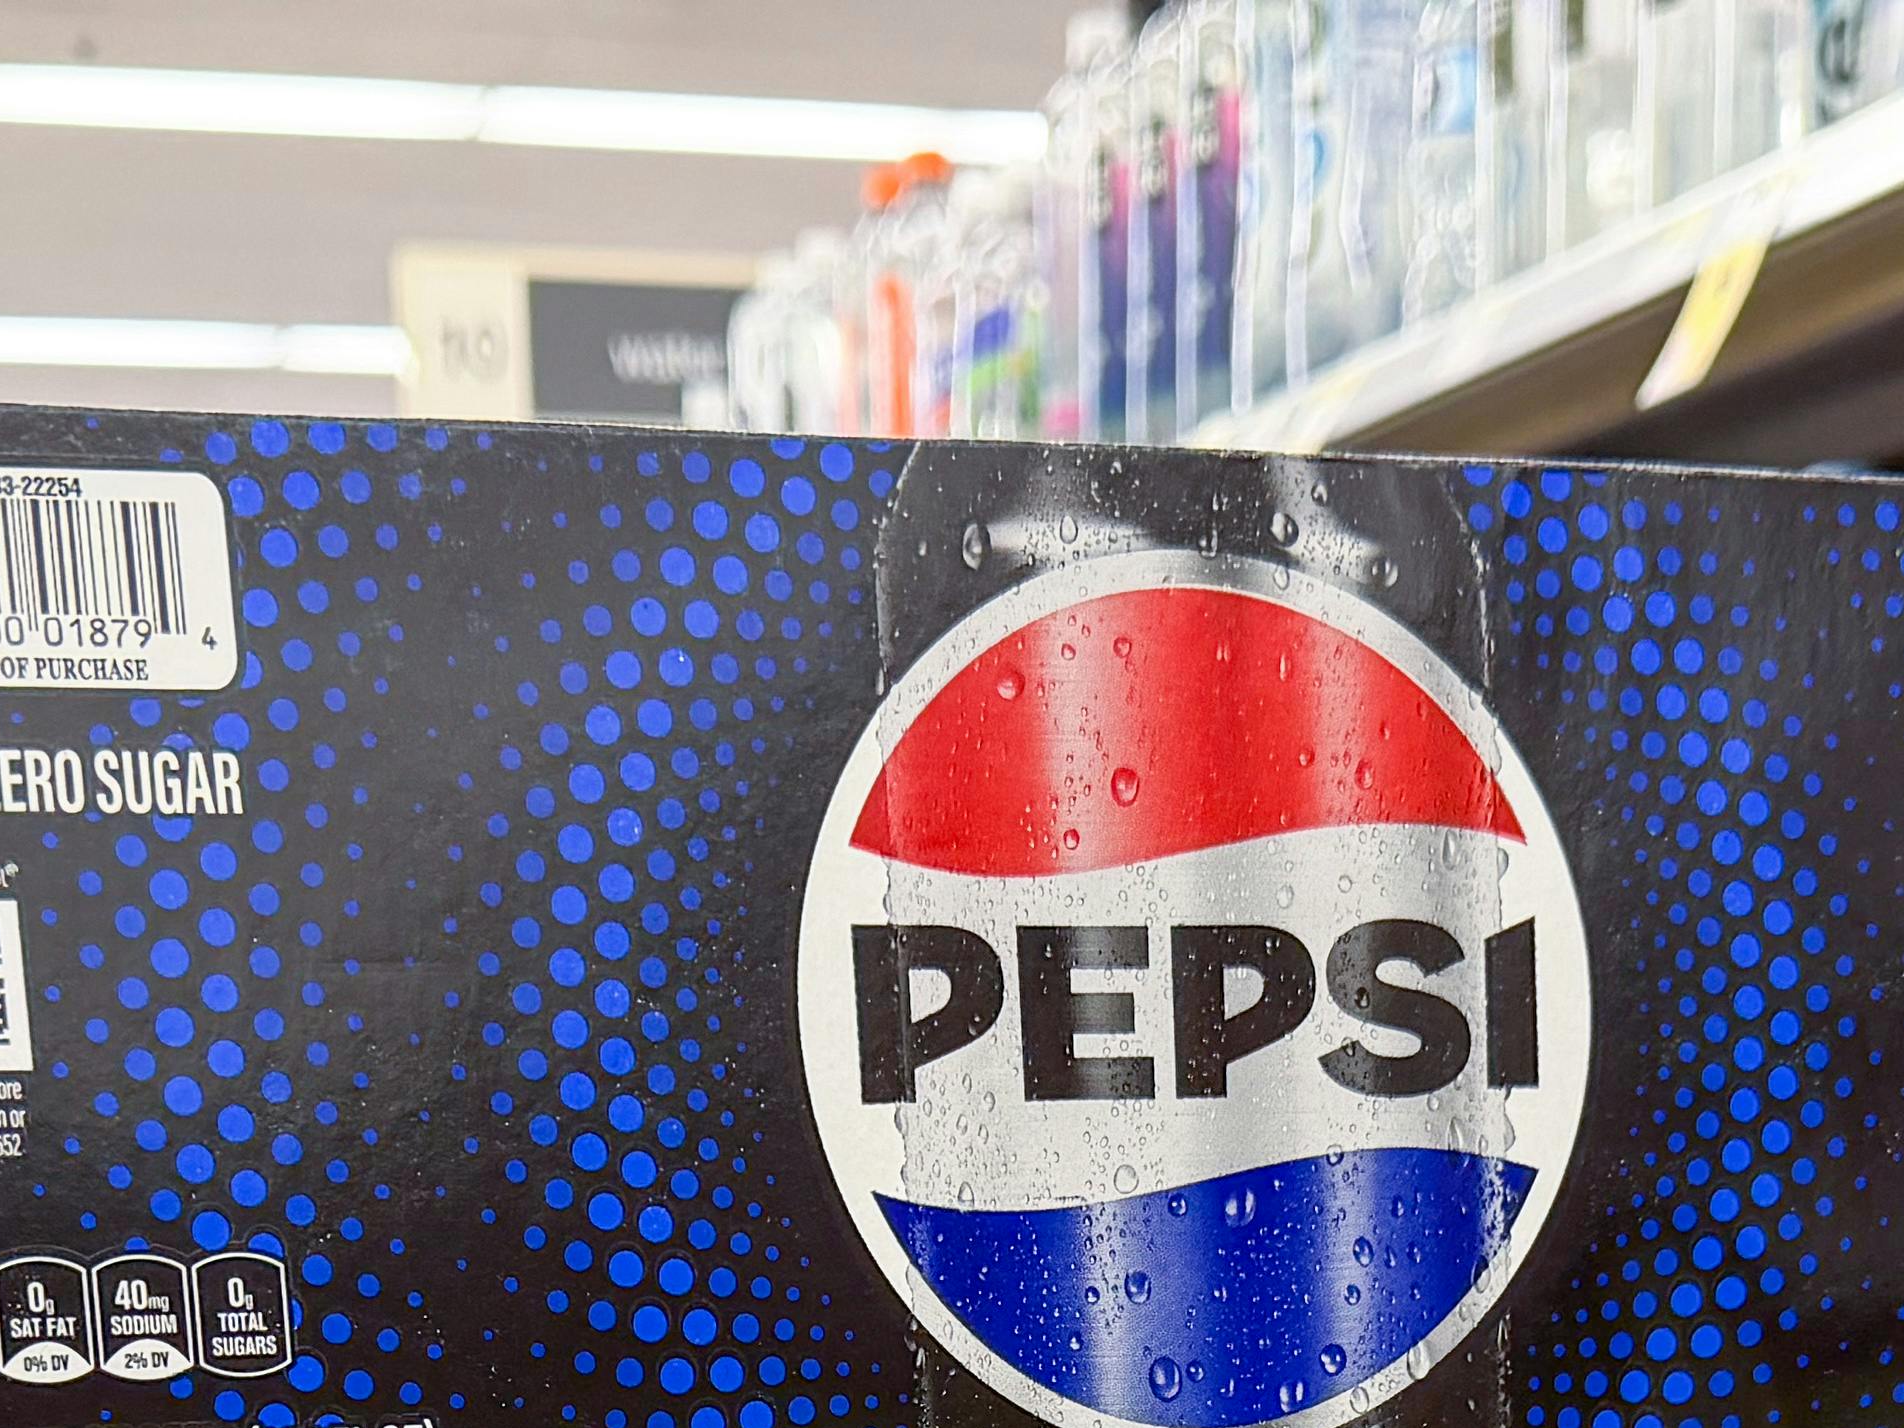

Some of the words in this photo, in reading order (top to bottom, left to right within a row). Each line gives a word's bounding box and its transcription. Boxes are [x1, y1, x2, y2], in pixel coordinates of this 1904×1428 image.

[44, 617, 153, 648] 01879
[202, 627, 218, 651] 4
[1, 656, 28, 680] OF
[34, 656, 149, 682] PURCHASE
[95, 750, 244, 815] SUGAR
[850, 917, 1541, 1107] PEPSI
